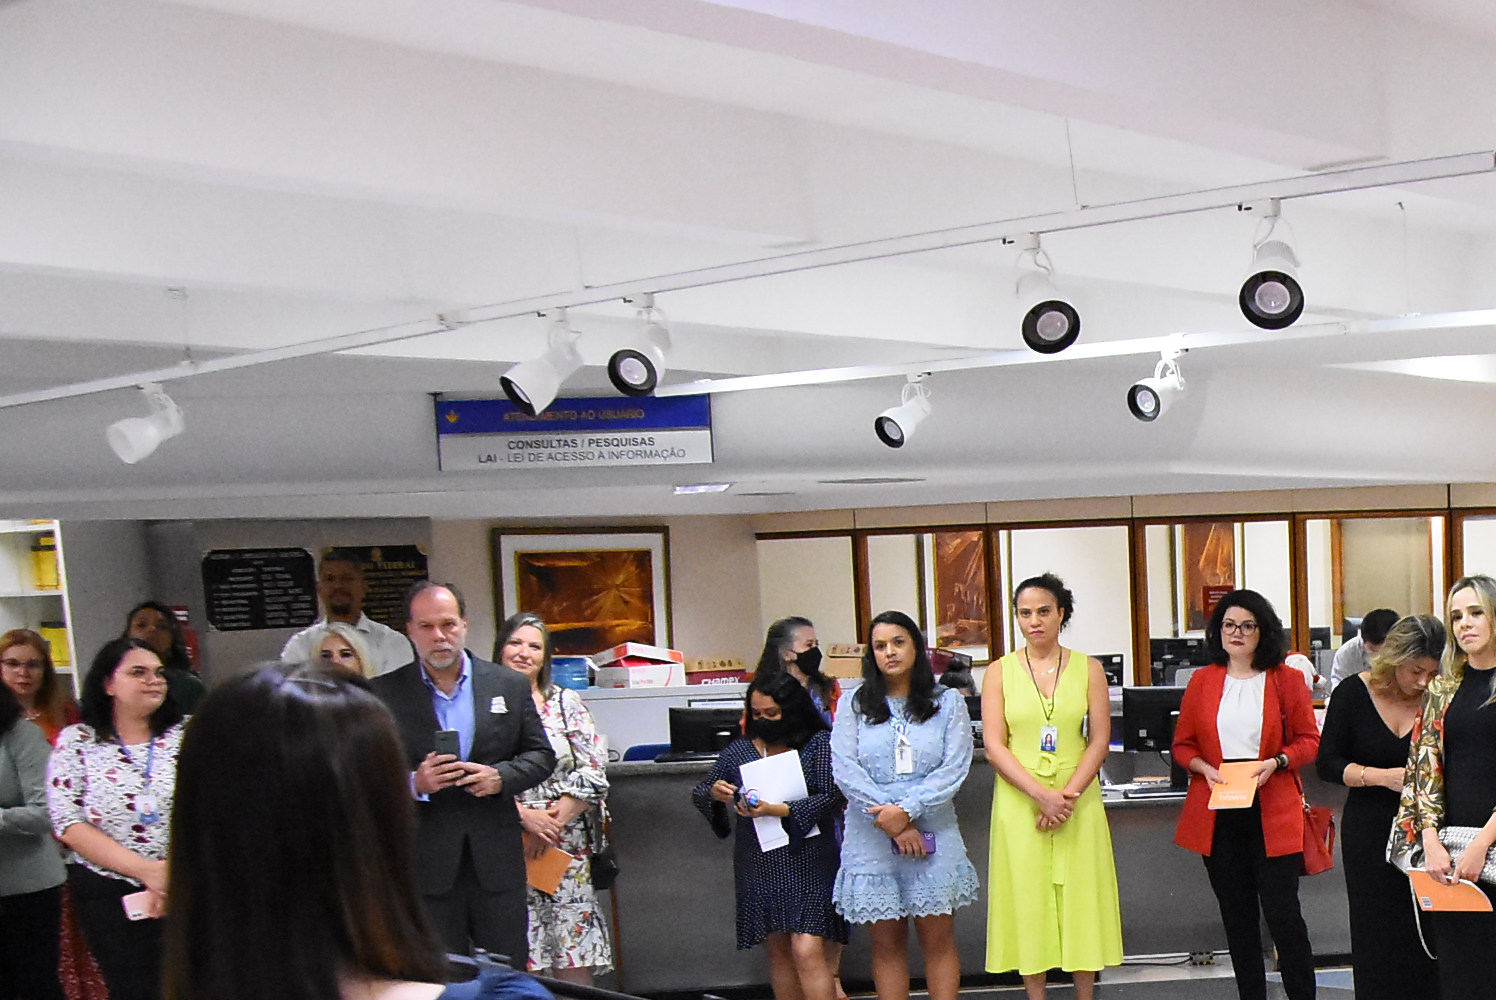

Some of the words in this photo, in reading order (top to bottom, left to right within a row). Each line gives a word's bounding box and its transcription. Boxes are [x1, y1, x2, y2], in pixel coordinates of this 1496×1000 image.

[507, 438, 578, 450] CONSULTAS
[587, 437, 655, 448] PESQUISAS
[478, 453, 498, 463] LAI
[507, 452, 525, 463] LEI
[528, 452, 544, 462] DE
[547, 451, 595, 462] ACESSO
[608, 446, 687, 461] INFORMAÇÃO
